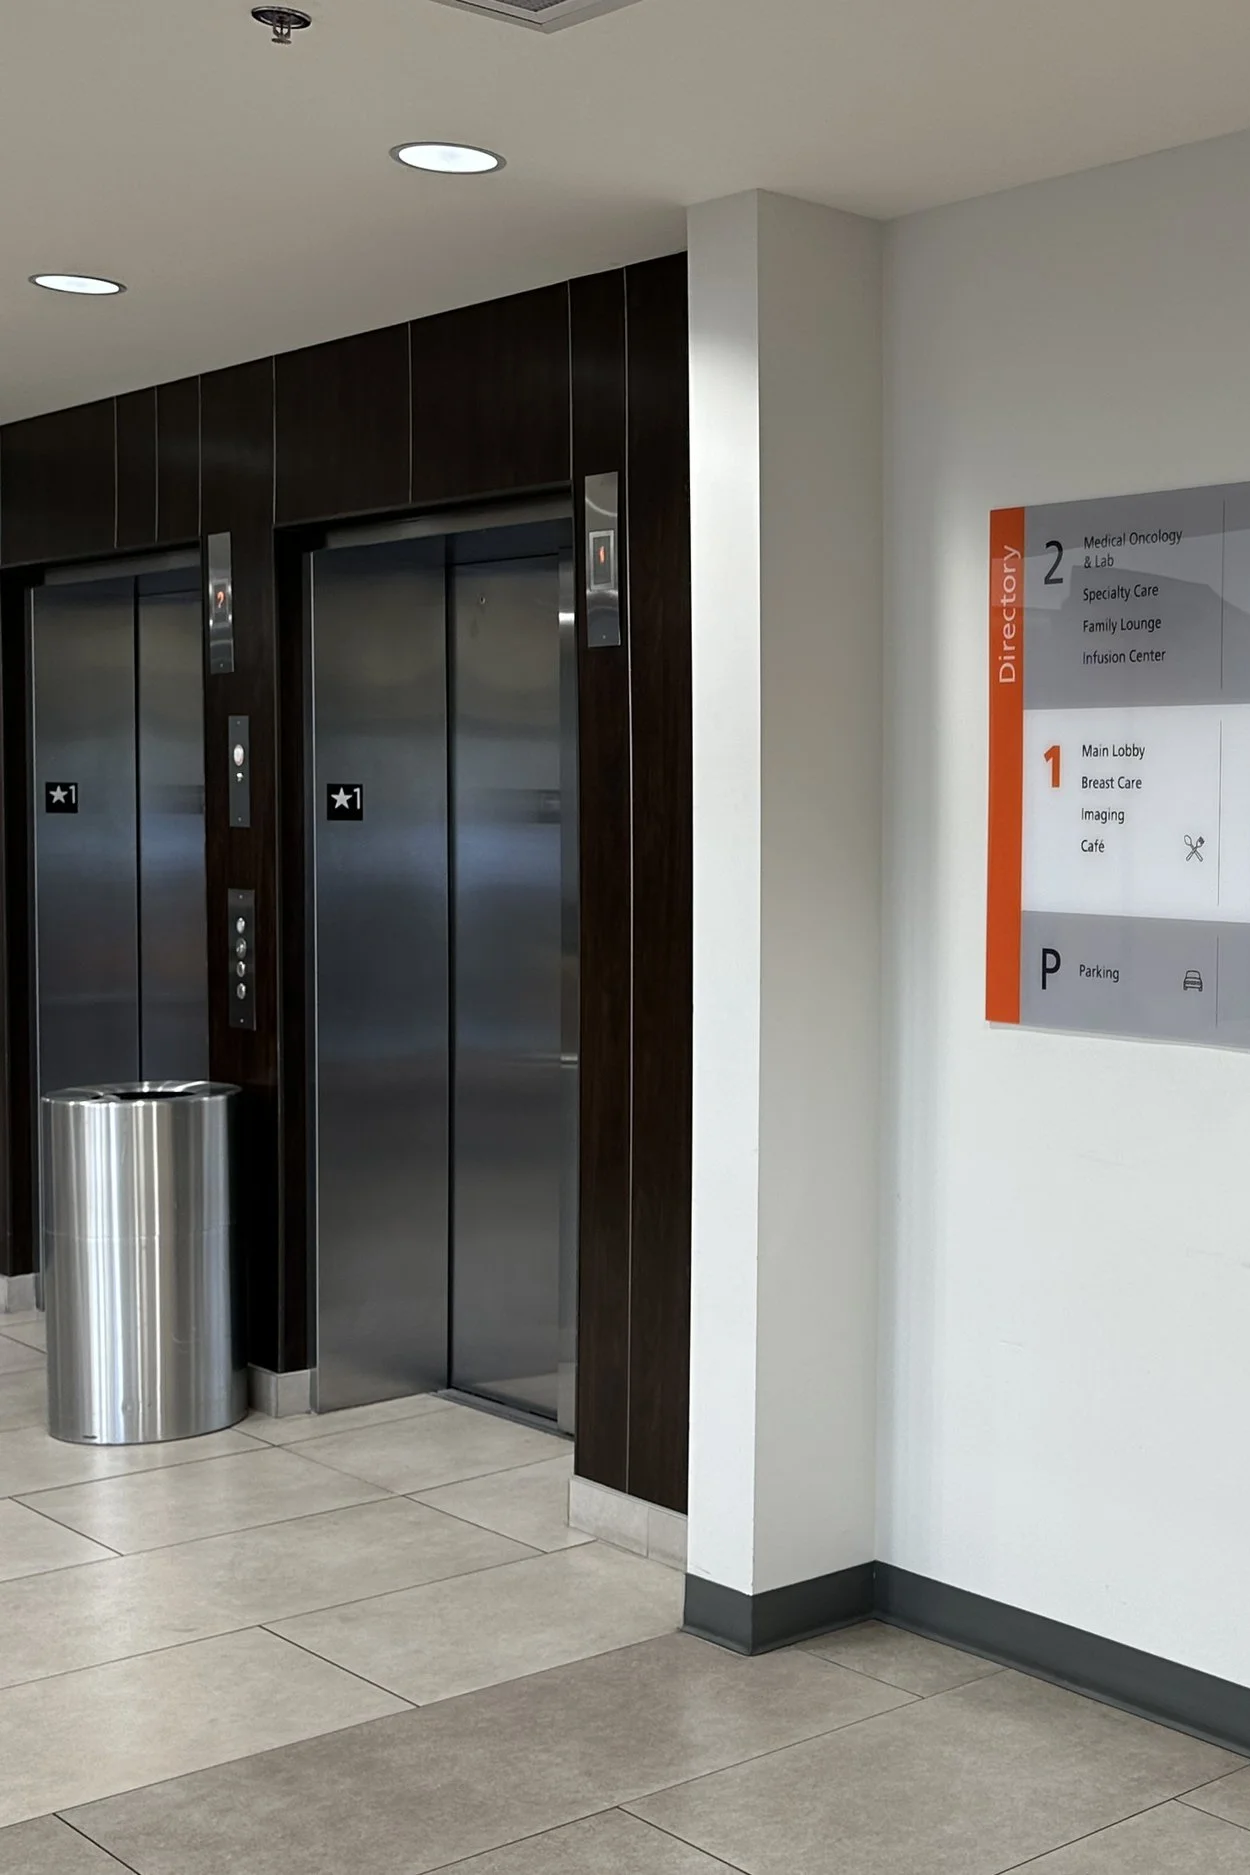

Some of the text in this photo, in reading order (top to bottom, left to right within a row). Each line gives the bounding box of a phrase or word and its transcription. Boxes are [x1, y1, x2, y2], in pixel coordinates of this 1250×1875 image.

[1083, 529, 1183, 549] Medical Oncology
[1044, 540, 1064, 585] 2
[1083, 554, 1115, 568] & Lab
[1083, 585, 1159, 603] Specialty Care
[998, 545, 1022, 684] Directory
[1083, 617, 1162, 635] Family Lounge
[1083, 650, 1167, 665] Infusion Center
[1082, 743, 1146, 760] Main Lobby
[1043, 745, 1061, 788] 1
[1081, 776, 1143, 789] Breast Care
[1081, 808, 1125, 825] Imaging
[1080, 839, 1106, 853] Café
[1042, 948, 1062, 990] P
[1079, 964, 1120, 983] Parking
